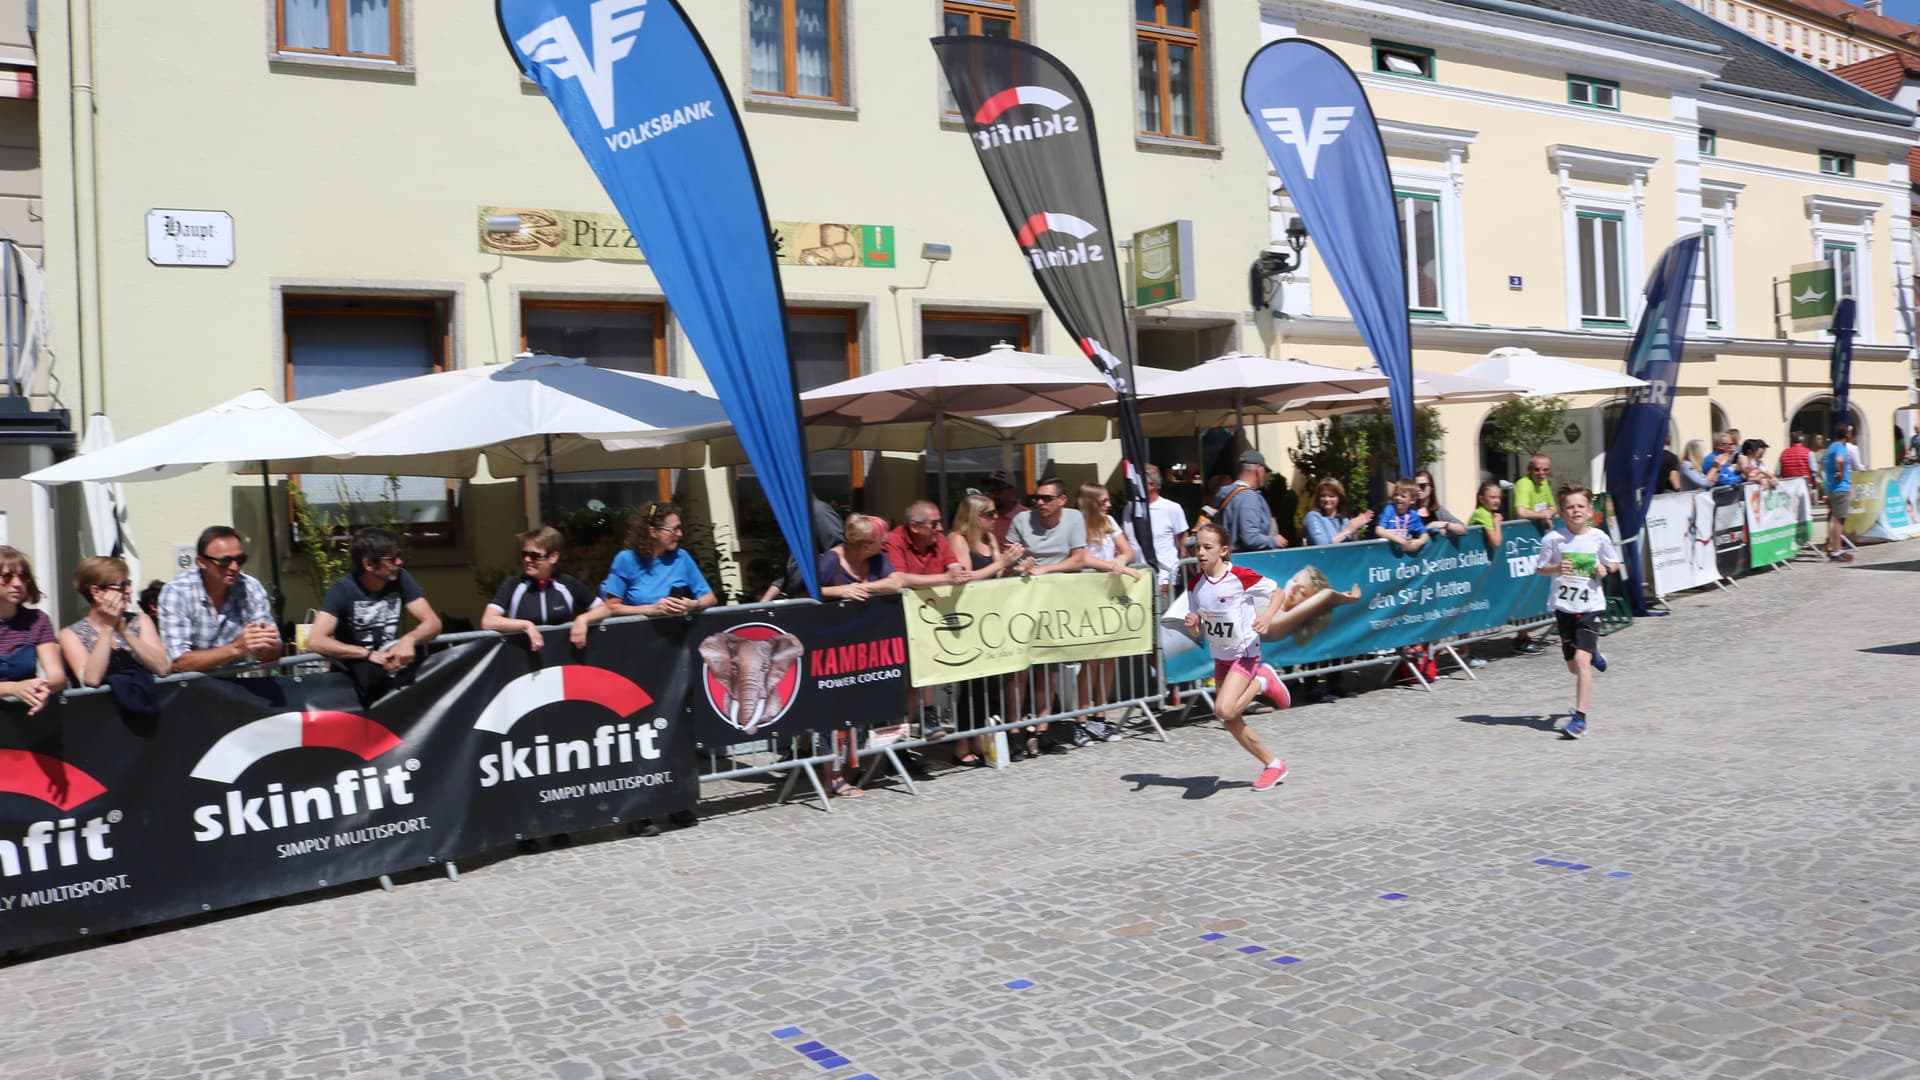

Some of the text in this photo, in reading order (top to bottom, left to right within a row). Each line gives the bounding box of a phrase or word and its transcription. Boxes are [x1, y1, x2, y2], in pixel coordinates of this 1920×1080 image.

[604, 100, 715, 152] VOLKSBANK
[573, 219, 640, 248] Pizz
[1368, 566, 1391, 583] Für
[1506, 554, 1539, 579] TEM
[1420, 585, 1433, 605] je
[1558, 585, 1589, 603] 274
[979, 602, 1146, 649] CORRADO
[1205, 622, 1234, 638] 247
[810, 637, 906, 676] KAMBAKU
[818, 669, 901, 690] POWER COCCAO
[538, 784, 587, 803] SIMPLY
[276, 836, 331, 858] SIMPLY
